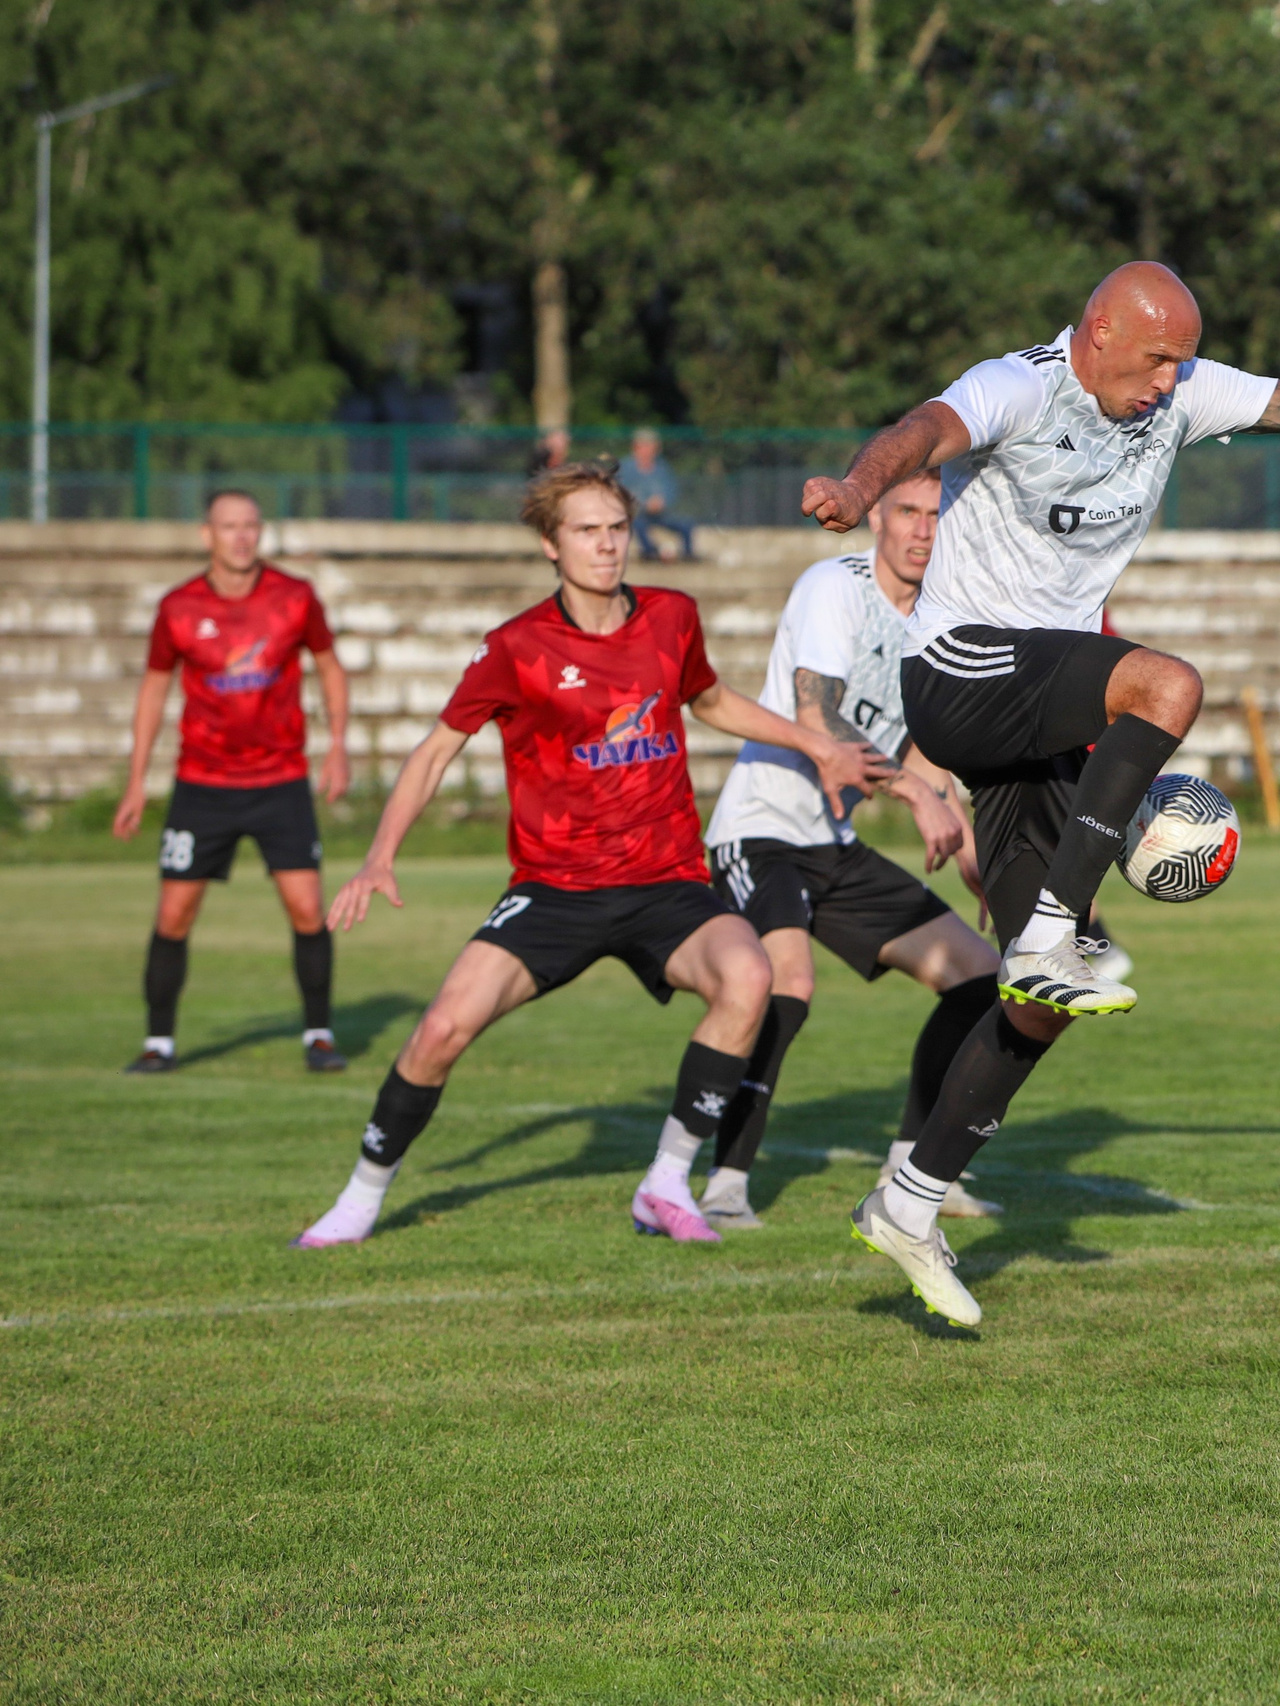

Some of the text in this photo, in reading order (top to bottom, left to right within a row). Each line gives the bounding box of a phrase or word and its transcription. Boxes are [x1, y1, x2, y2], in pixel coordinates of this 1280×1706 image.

[1088, 503, 1142, 520] Coin Tab
[1076, 813, 1122, 839] JÖGEL
